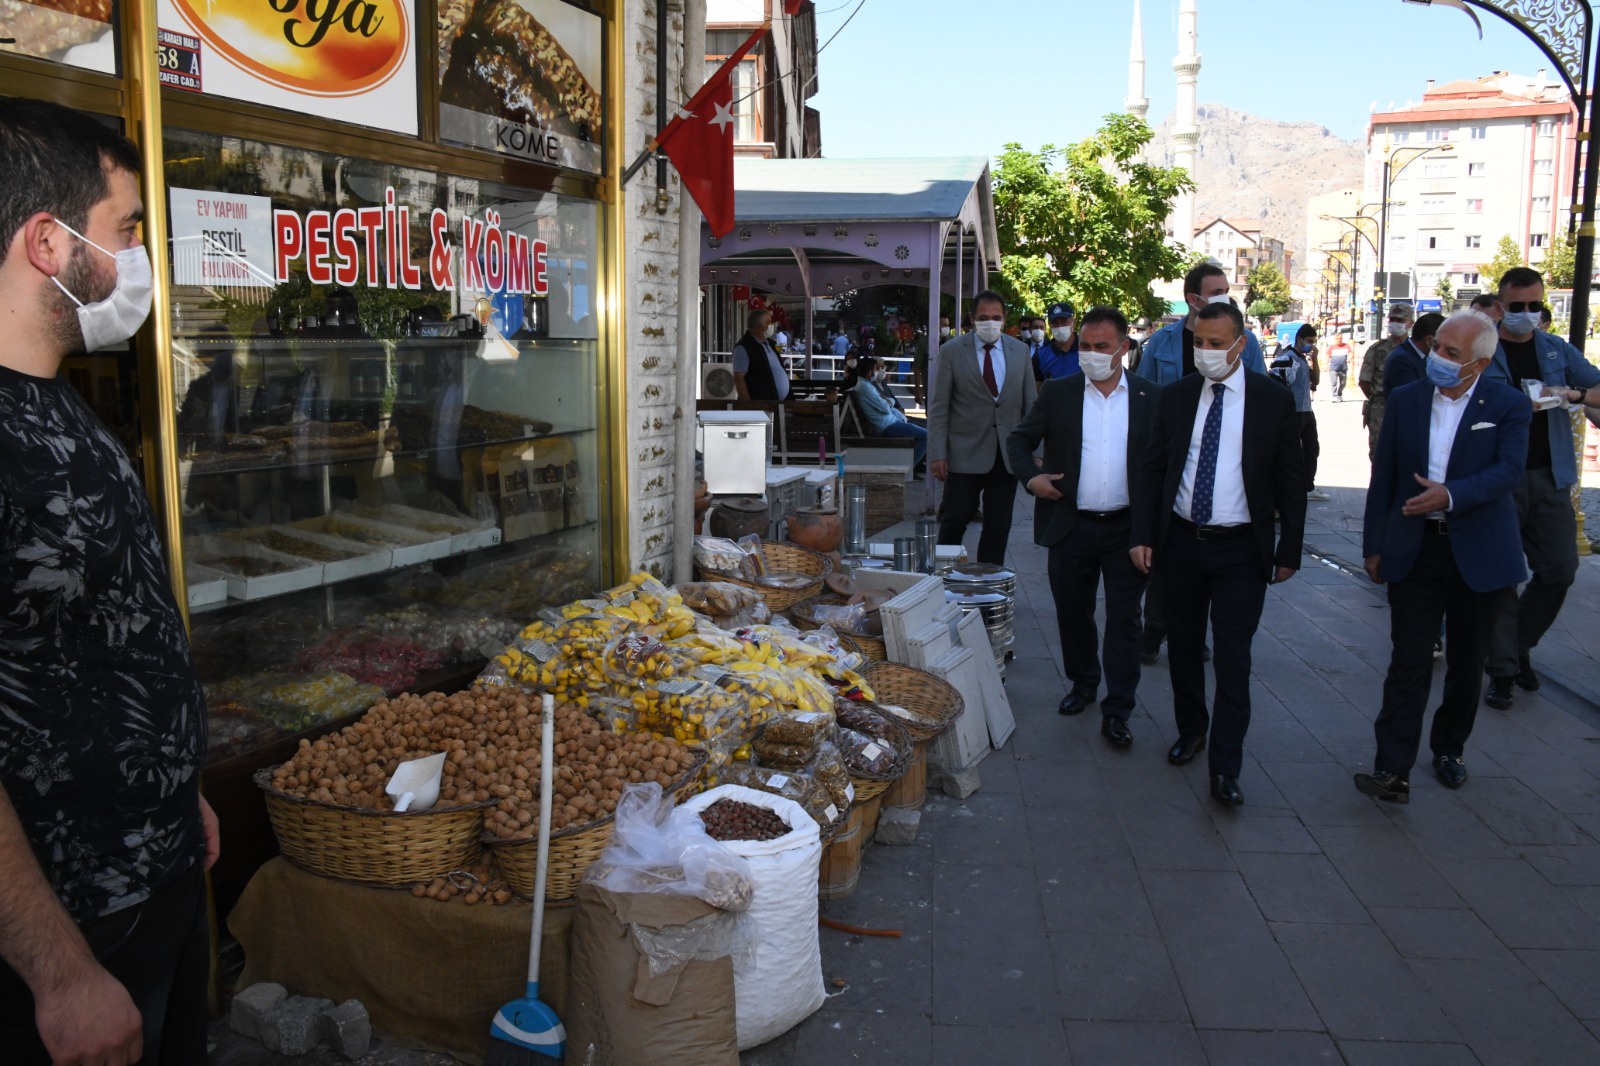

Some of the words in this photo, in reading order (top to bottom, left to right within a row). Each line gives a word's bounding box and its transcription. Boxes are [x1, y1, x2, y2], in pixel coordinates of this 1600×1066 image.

[190, 53, 199, 75] A
[496, 123, 559, 160] KÖME
[197, 199, 210, 216] EV
[213, 201, 248, 219] YAPIMI
[202, 228, 246, 253] PESTİL
[274, 186, 421, 290] PESTİL
[429, 208, 456, 291] &
[463, 207, 549, 294] KÖME
